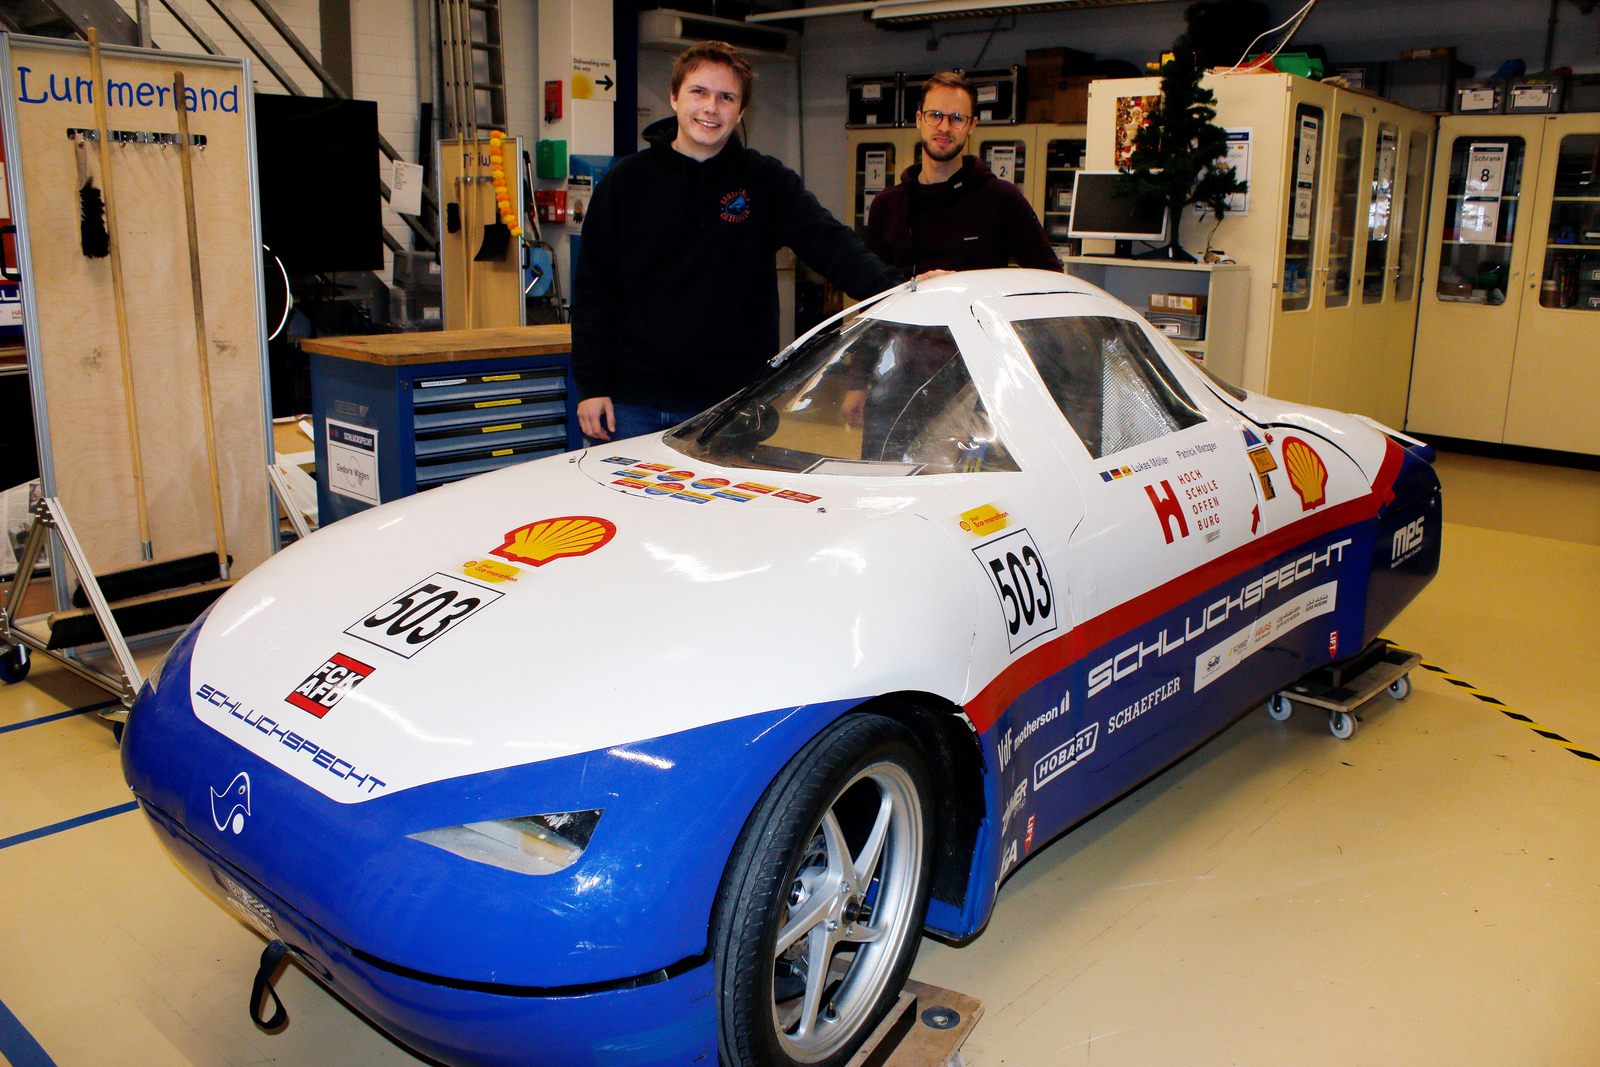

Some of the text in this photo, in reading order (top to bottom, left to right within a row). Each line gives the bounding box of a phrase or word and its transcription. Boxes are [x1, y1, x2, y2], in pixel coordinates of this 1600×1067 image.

[17, 66, 239, 113] Lummerland
[1305, 148, 1311, 164] 6
[1473, 154, 1502, 162] Schrank
[874, 169, 878, 180] 1
[1000, 166, 1006, 177] 2
[1480, 168, 1490, 182] 8
[1176, 446, 1198, 459] Patrick
[336, 463, 354, 476] Gedore
[1130, 460, 1152, 473] Lukas
[1177, 469, 1203, 485] HOCH
[1186, 480, 1219, 500] SCHULE
[1192, 496, 1220, 515] OFFEN
[973, 511, 1009, 528] Eco-marathon
[1197, 513, 1220, 531] BURG
[1392, 515, 1425, 560] MPS
[474, 566, 518, 582] Eco-marathon
[989, 545, 1051, 636] 503
[364, 583, 481, 645] 503
[1088, 538, 1352, 698] SCHLUCKSPECHT
[313, 661, 365, 691] FCK
[295, 677, 346, 707] AFD
[1108, 677, 1180, 734] SCHAEFFLER
[196, 684, 386, 793] SCHLUCKSPECHT
[998, 707, 1058, 772] VdF motherson
[1039, 732, 1093, 778] HOBART
[1026, 815, 1034, 842] LIFT
